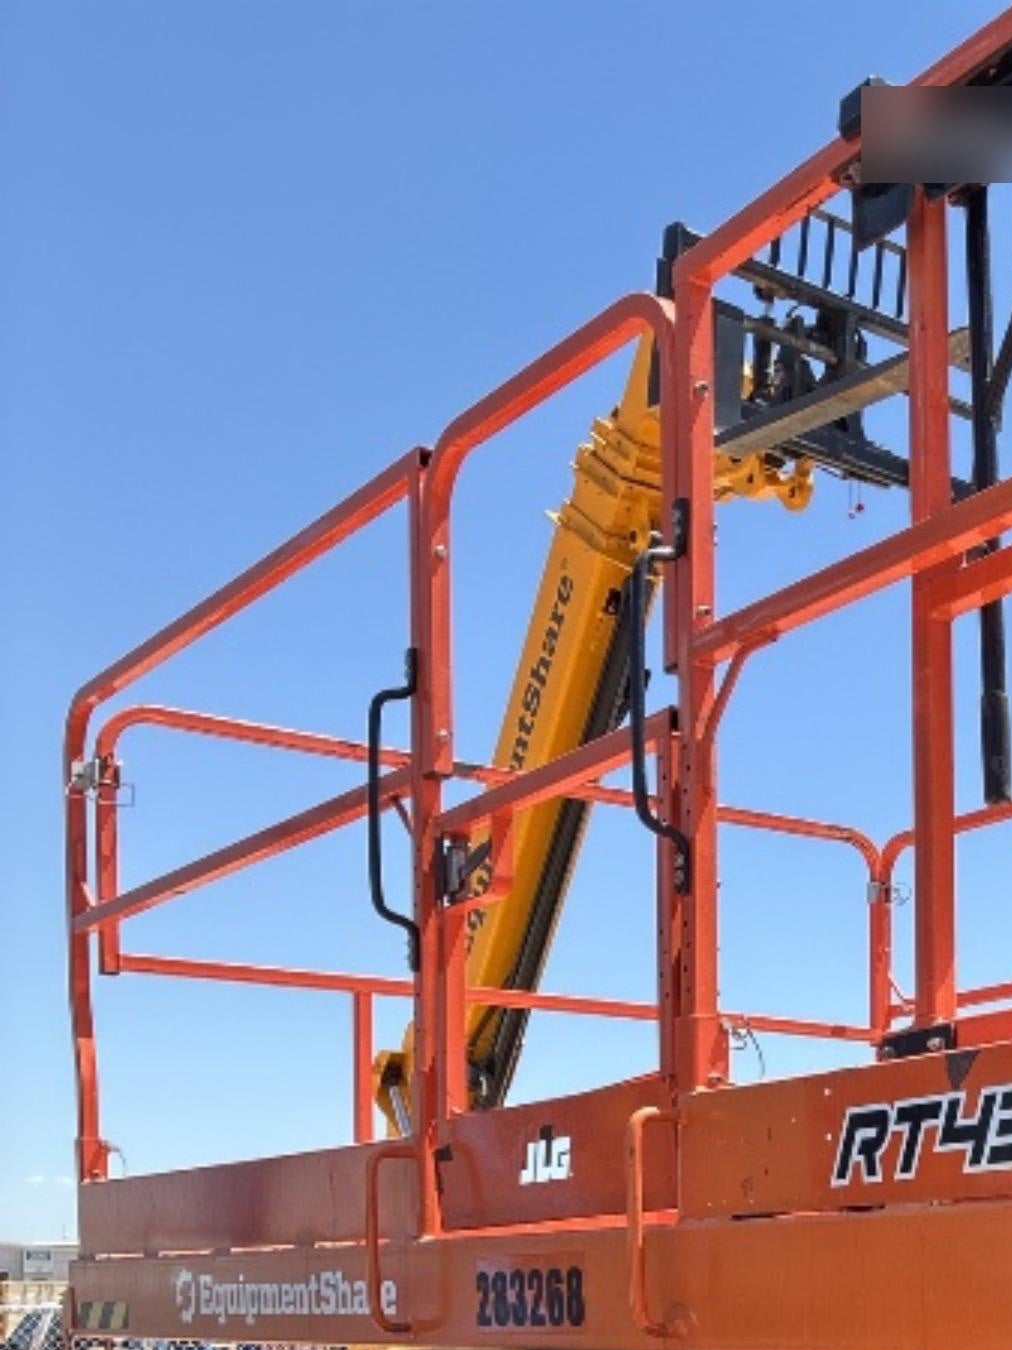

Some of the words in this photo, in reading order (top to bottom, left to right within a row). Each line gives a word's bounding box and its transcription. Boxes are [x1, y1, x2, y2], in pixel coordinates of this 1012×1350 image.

[519, 1136, 571, 1186] JLG
[199, 1271, 397, 1325] EquipmentShae
[476, 1266, 585, 1326] 283268
